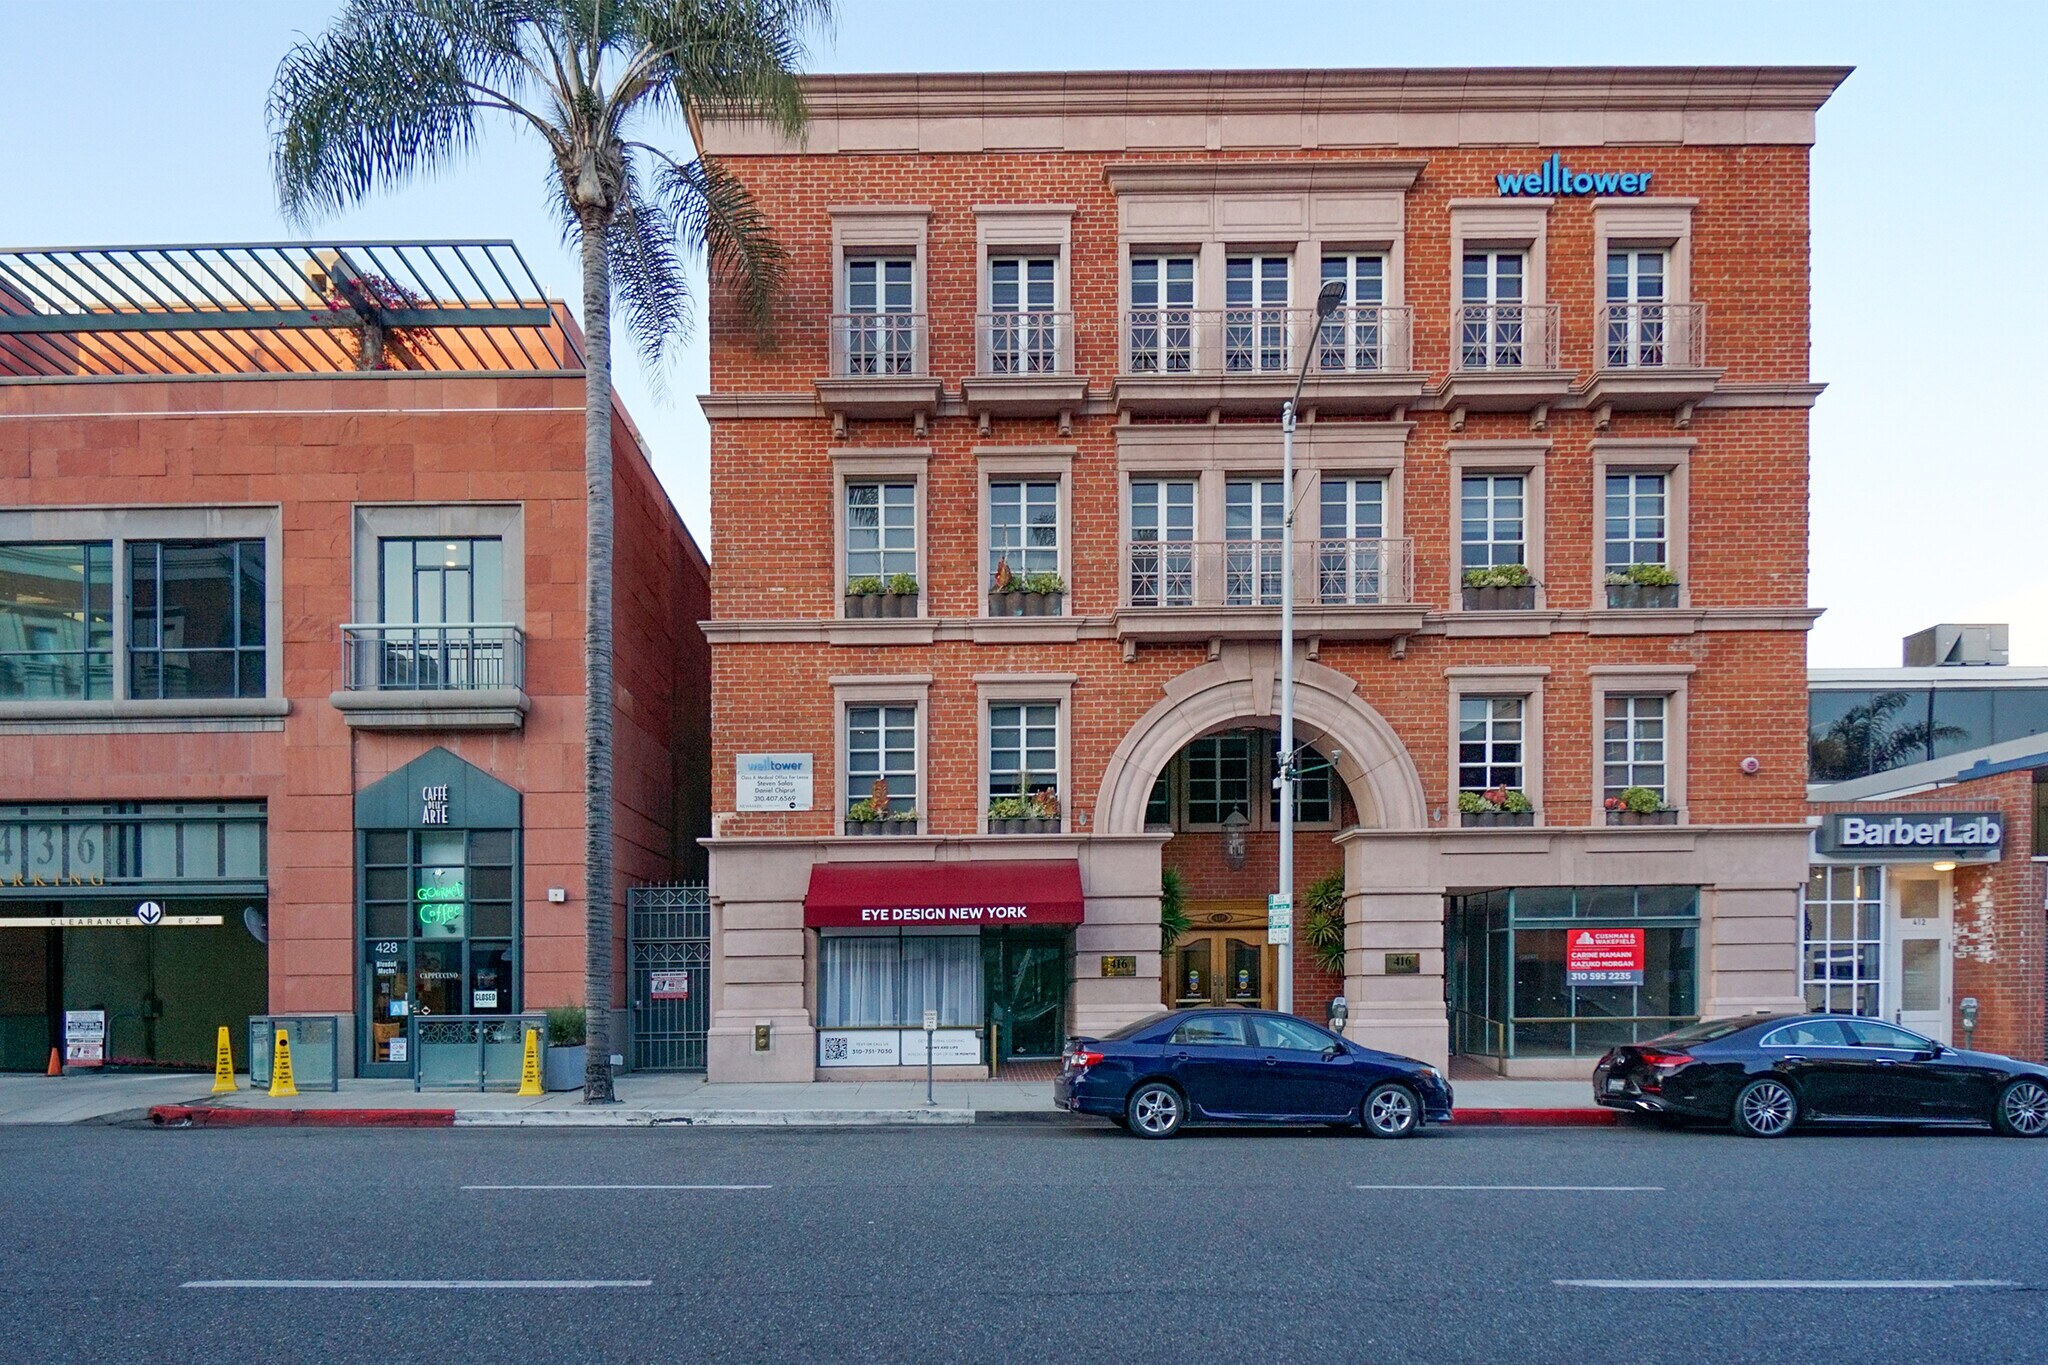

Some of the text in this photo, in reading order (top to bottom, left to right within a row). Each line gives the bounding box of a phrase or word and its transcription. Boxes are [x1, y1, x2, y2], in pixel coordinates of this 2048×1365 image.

[1497, 152, 1652, 196] welltower
[748, 756, 802, 770] welltower
[423, 805, 448, 823] ARTE
[1841, 816, 2000, 845] BarberLab
[0, 873, 104, 886] RKING
[420, 904, 460, 925] Coffee
[862, 907, 1027, 920] EYE DESIGN NEW YORK
[376, 942, 398, 953] 428
[1110, 960, 1127, 969] 416
[1394, 956, 1412, 967] 416
[475, 993, 495, 1001] CLOSED
